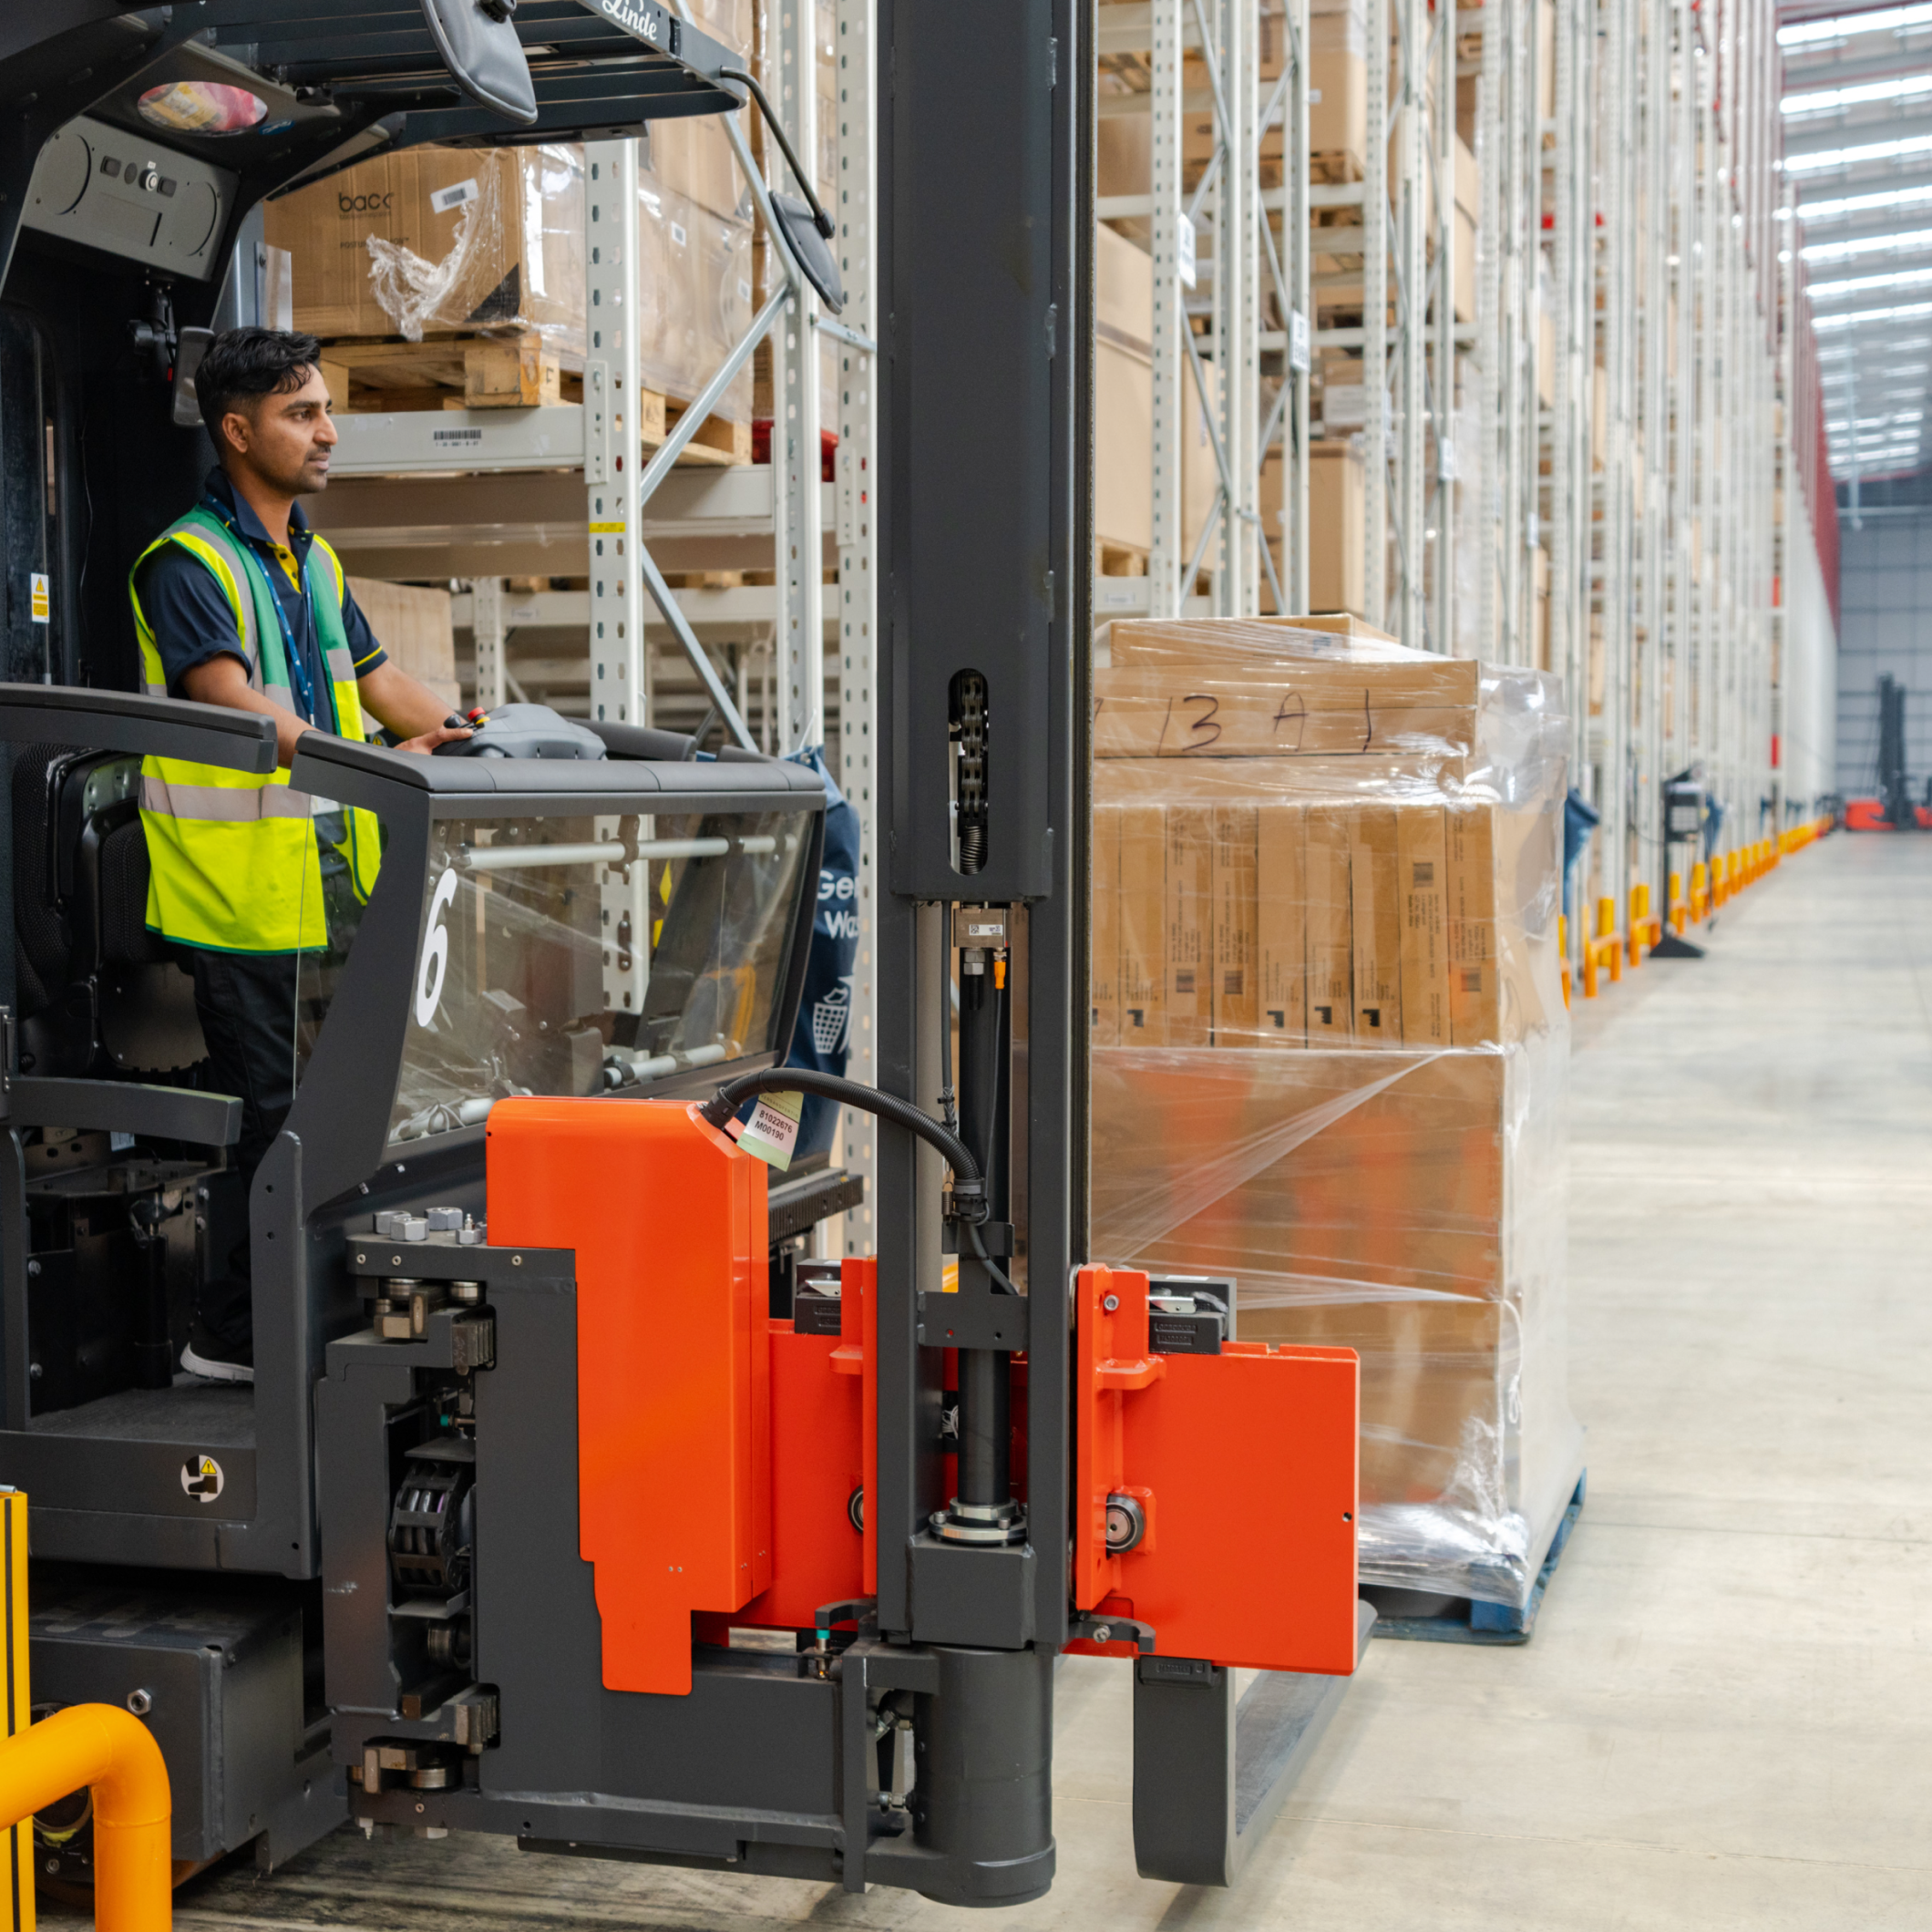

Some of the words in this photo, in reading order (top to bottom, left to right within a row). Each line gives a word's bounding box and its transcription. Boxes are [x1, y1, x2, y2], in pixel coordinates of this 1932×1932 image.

[602, 0, 657, 41] Linde
[1273, 691, 1310, 752] A
[416, 868, 457, 1027] 6
[755, 1120, 785, 1141] M00190
[759, 1109, 793, 1134] 81022676
